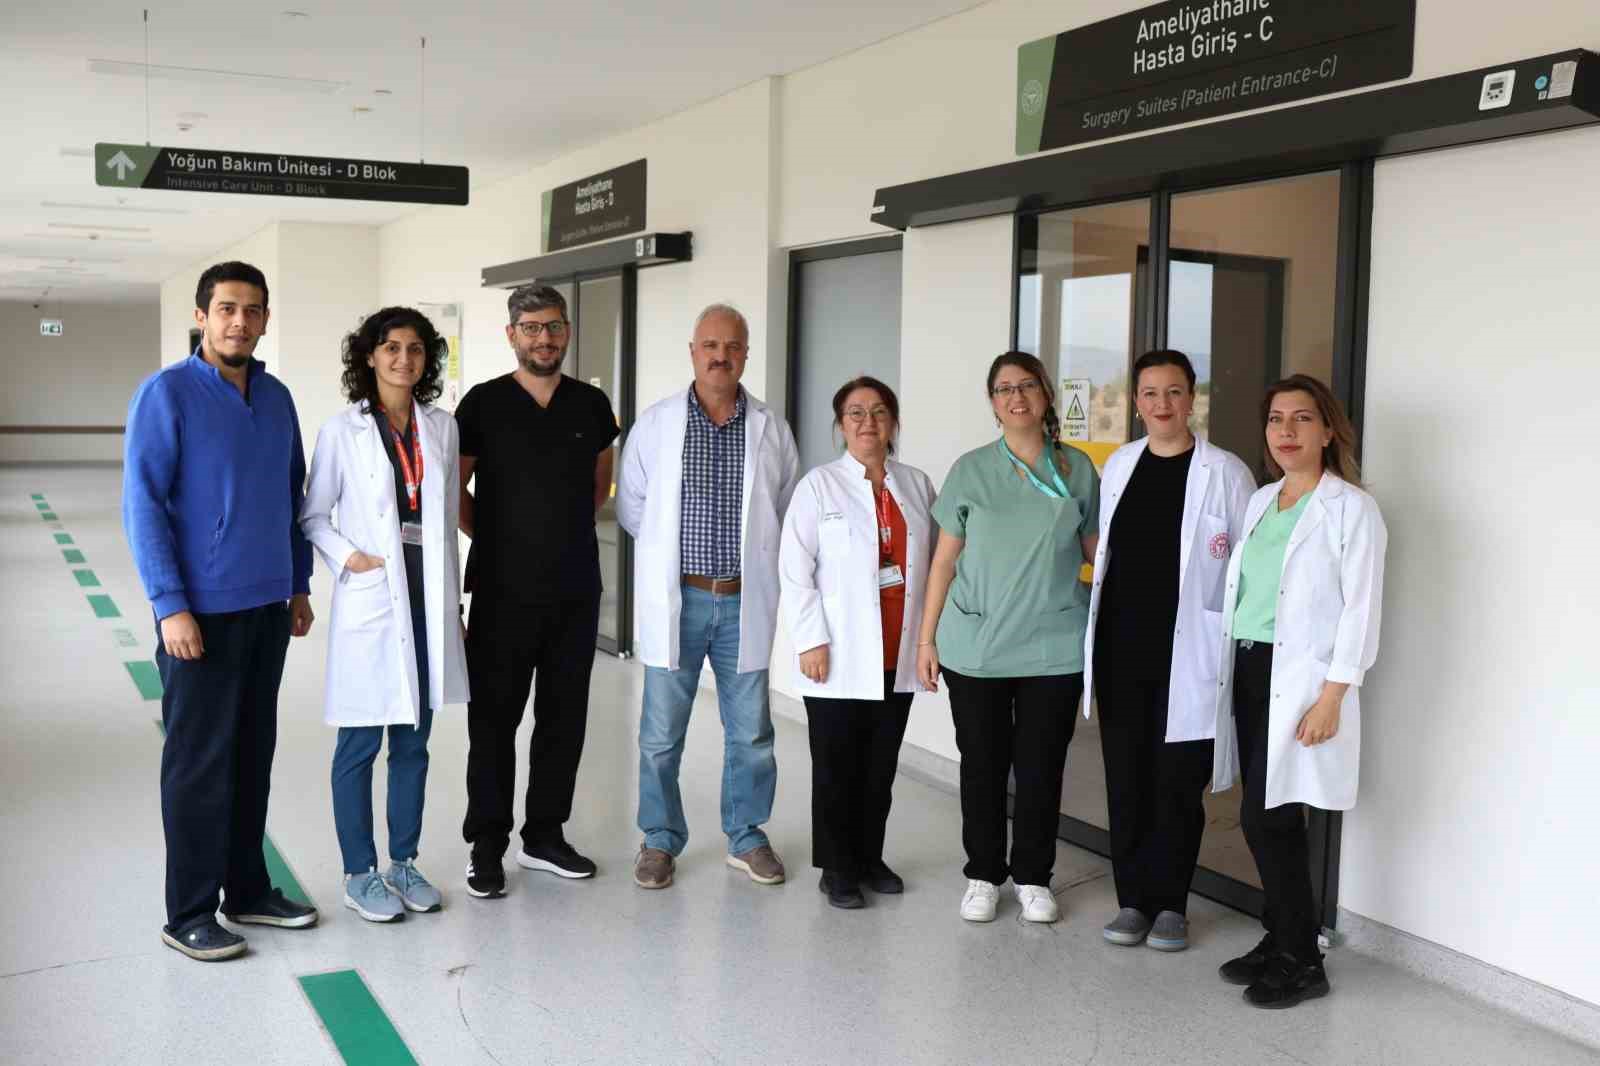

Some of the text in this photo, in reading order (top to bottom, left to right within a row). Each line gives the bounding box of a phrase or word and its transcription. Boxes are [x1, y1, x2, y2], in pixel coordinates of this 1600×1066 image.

[1133, 42, 1185, 74] Hasta
[1191, 29, 1237, 57] Giriş
[1259, 16, 1274, 41] C
[1081, 54, 1338, 129] Surgery Suites (Patient Entrance-C)
[167, 152, 217, 172] Yoğun
[223, 156, 272, 173] Bakım
[277, 156, 333, 177] Ünitesi
[348, 164, 358, 179] D
[363, 165, 397, 181] Blok
[167, 175, 218, 191] Intensive
[222, 179, 248, 192] Care
[252, 179, 273, 193] Unit
[285, 183, 293, 194] D
[296, 183, 327, 196] Block
